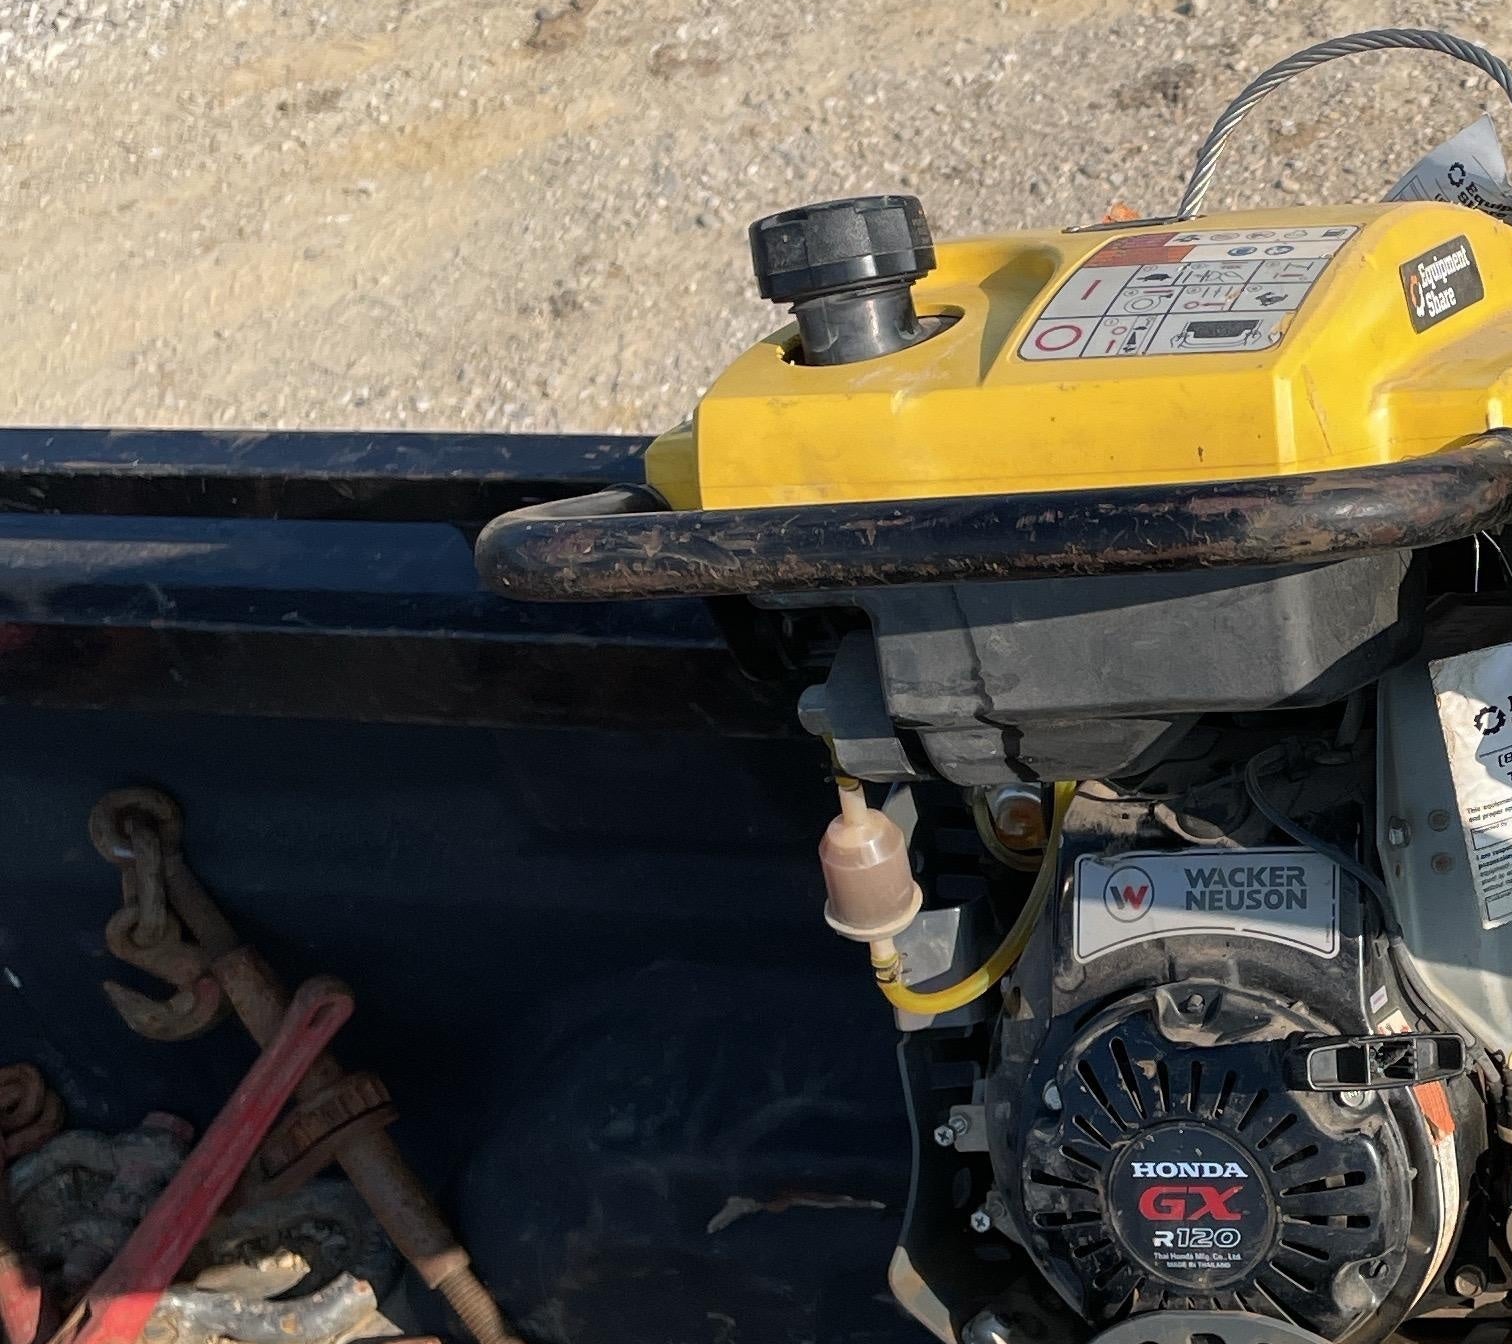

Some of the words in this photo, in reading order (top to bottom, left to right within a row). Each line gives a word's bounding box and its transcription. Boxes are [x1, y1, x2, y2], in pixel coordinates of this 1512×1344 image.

[1417, 245, 1471, 290] Equipment
[1425, 287, 1457, 318] Share
[1184, 865, 1307, 889] WACKER
[1185, 888, 1308, 911] NEUSON
[1131, 1162, 1249, 1178] HONDA
[1138, 1184, 1246, 1221] GX
[1153, 1227, 1242, 1249] R120
[1170, 1252, 1194, 1260] Honda
